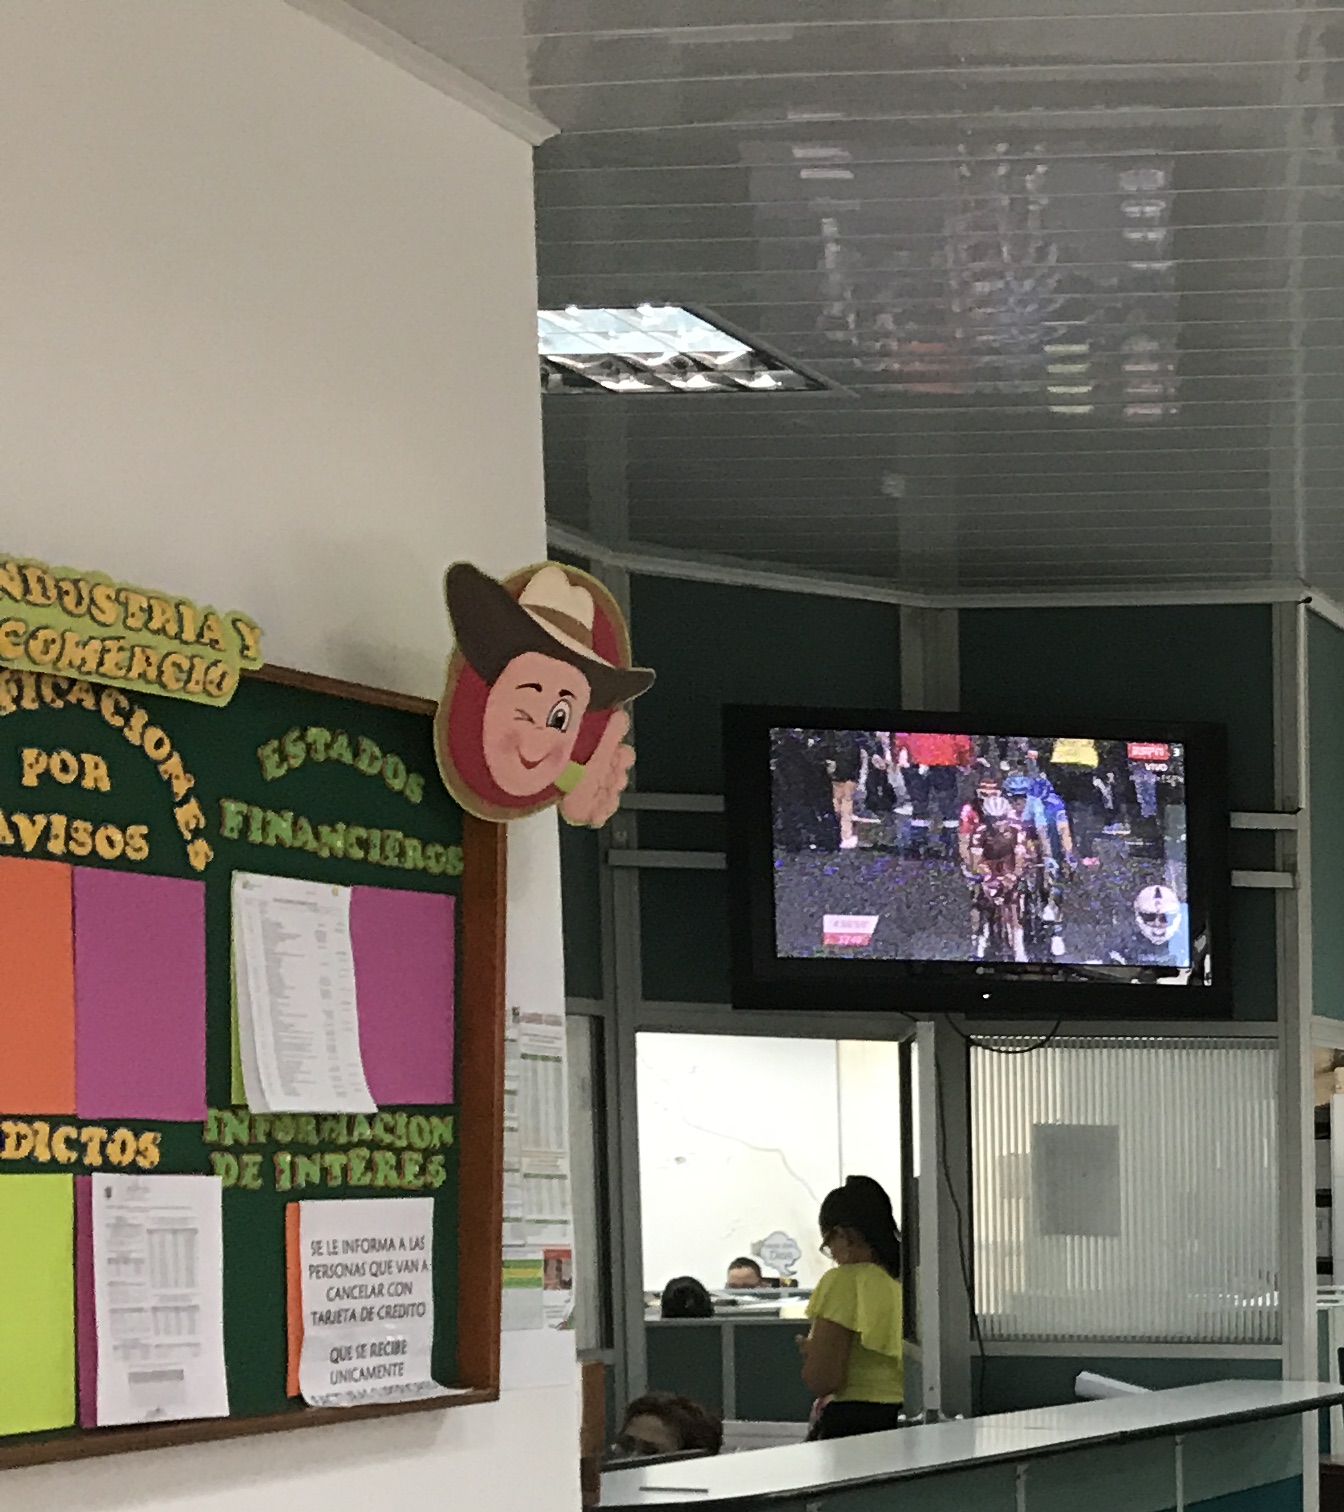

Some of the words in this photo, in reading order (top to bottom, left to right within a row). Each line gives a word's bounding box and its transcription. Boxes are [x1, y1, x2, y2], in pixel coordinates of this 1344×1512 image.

[0, 617, 236, 698] COMERCIO
[232, 618, 262, 661] Y
[21, 747, 111, 792] POR
[257, 726, 425, 804] ESTADOS
[219, 799, 464, 876] FINANCIEROS
[202, 1107, 455, 1151] INFORMACION
[210, 1151, 263, 1191] DE
[273, 1147, 447, 1193] INTERES
[310, 1240, 323, 1257] SE
[326, 1239, 339, 1256] LE
[341, 1237, 396, 1255] INFORMA
[398, 1237, 407, 1252] A
[409, 1235, 425, 1251] LAS
[308, 1261, 367, 1280] PERSONAS
[368, 1260, 394, 1279] QUE
[396, 1258, 419, 1275] VAN
[420, 1258, 430, 1274] A
[326, 1281, 386, 1302] CANCELAR
[387, 1280, 413, 1298] CON
[310, 1307, 357, 1327] TARJETA
[360, 1304, 374, 1322] DE
[376, 1301, 427, 1320] CREDITO
[329, 1346, 353, 1365] QUE
[355, 1343, 368, 1360] SE
[369, 1338, 408, 1358] RECIBE
[329, 1361, 405, 1386] UNICAMENTE
